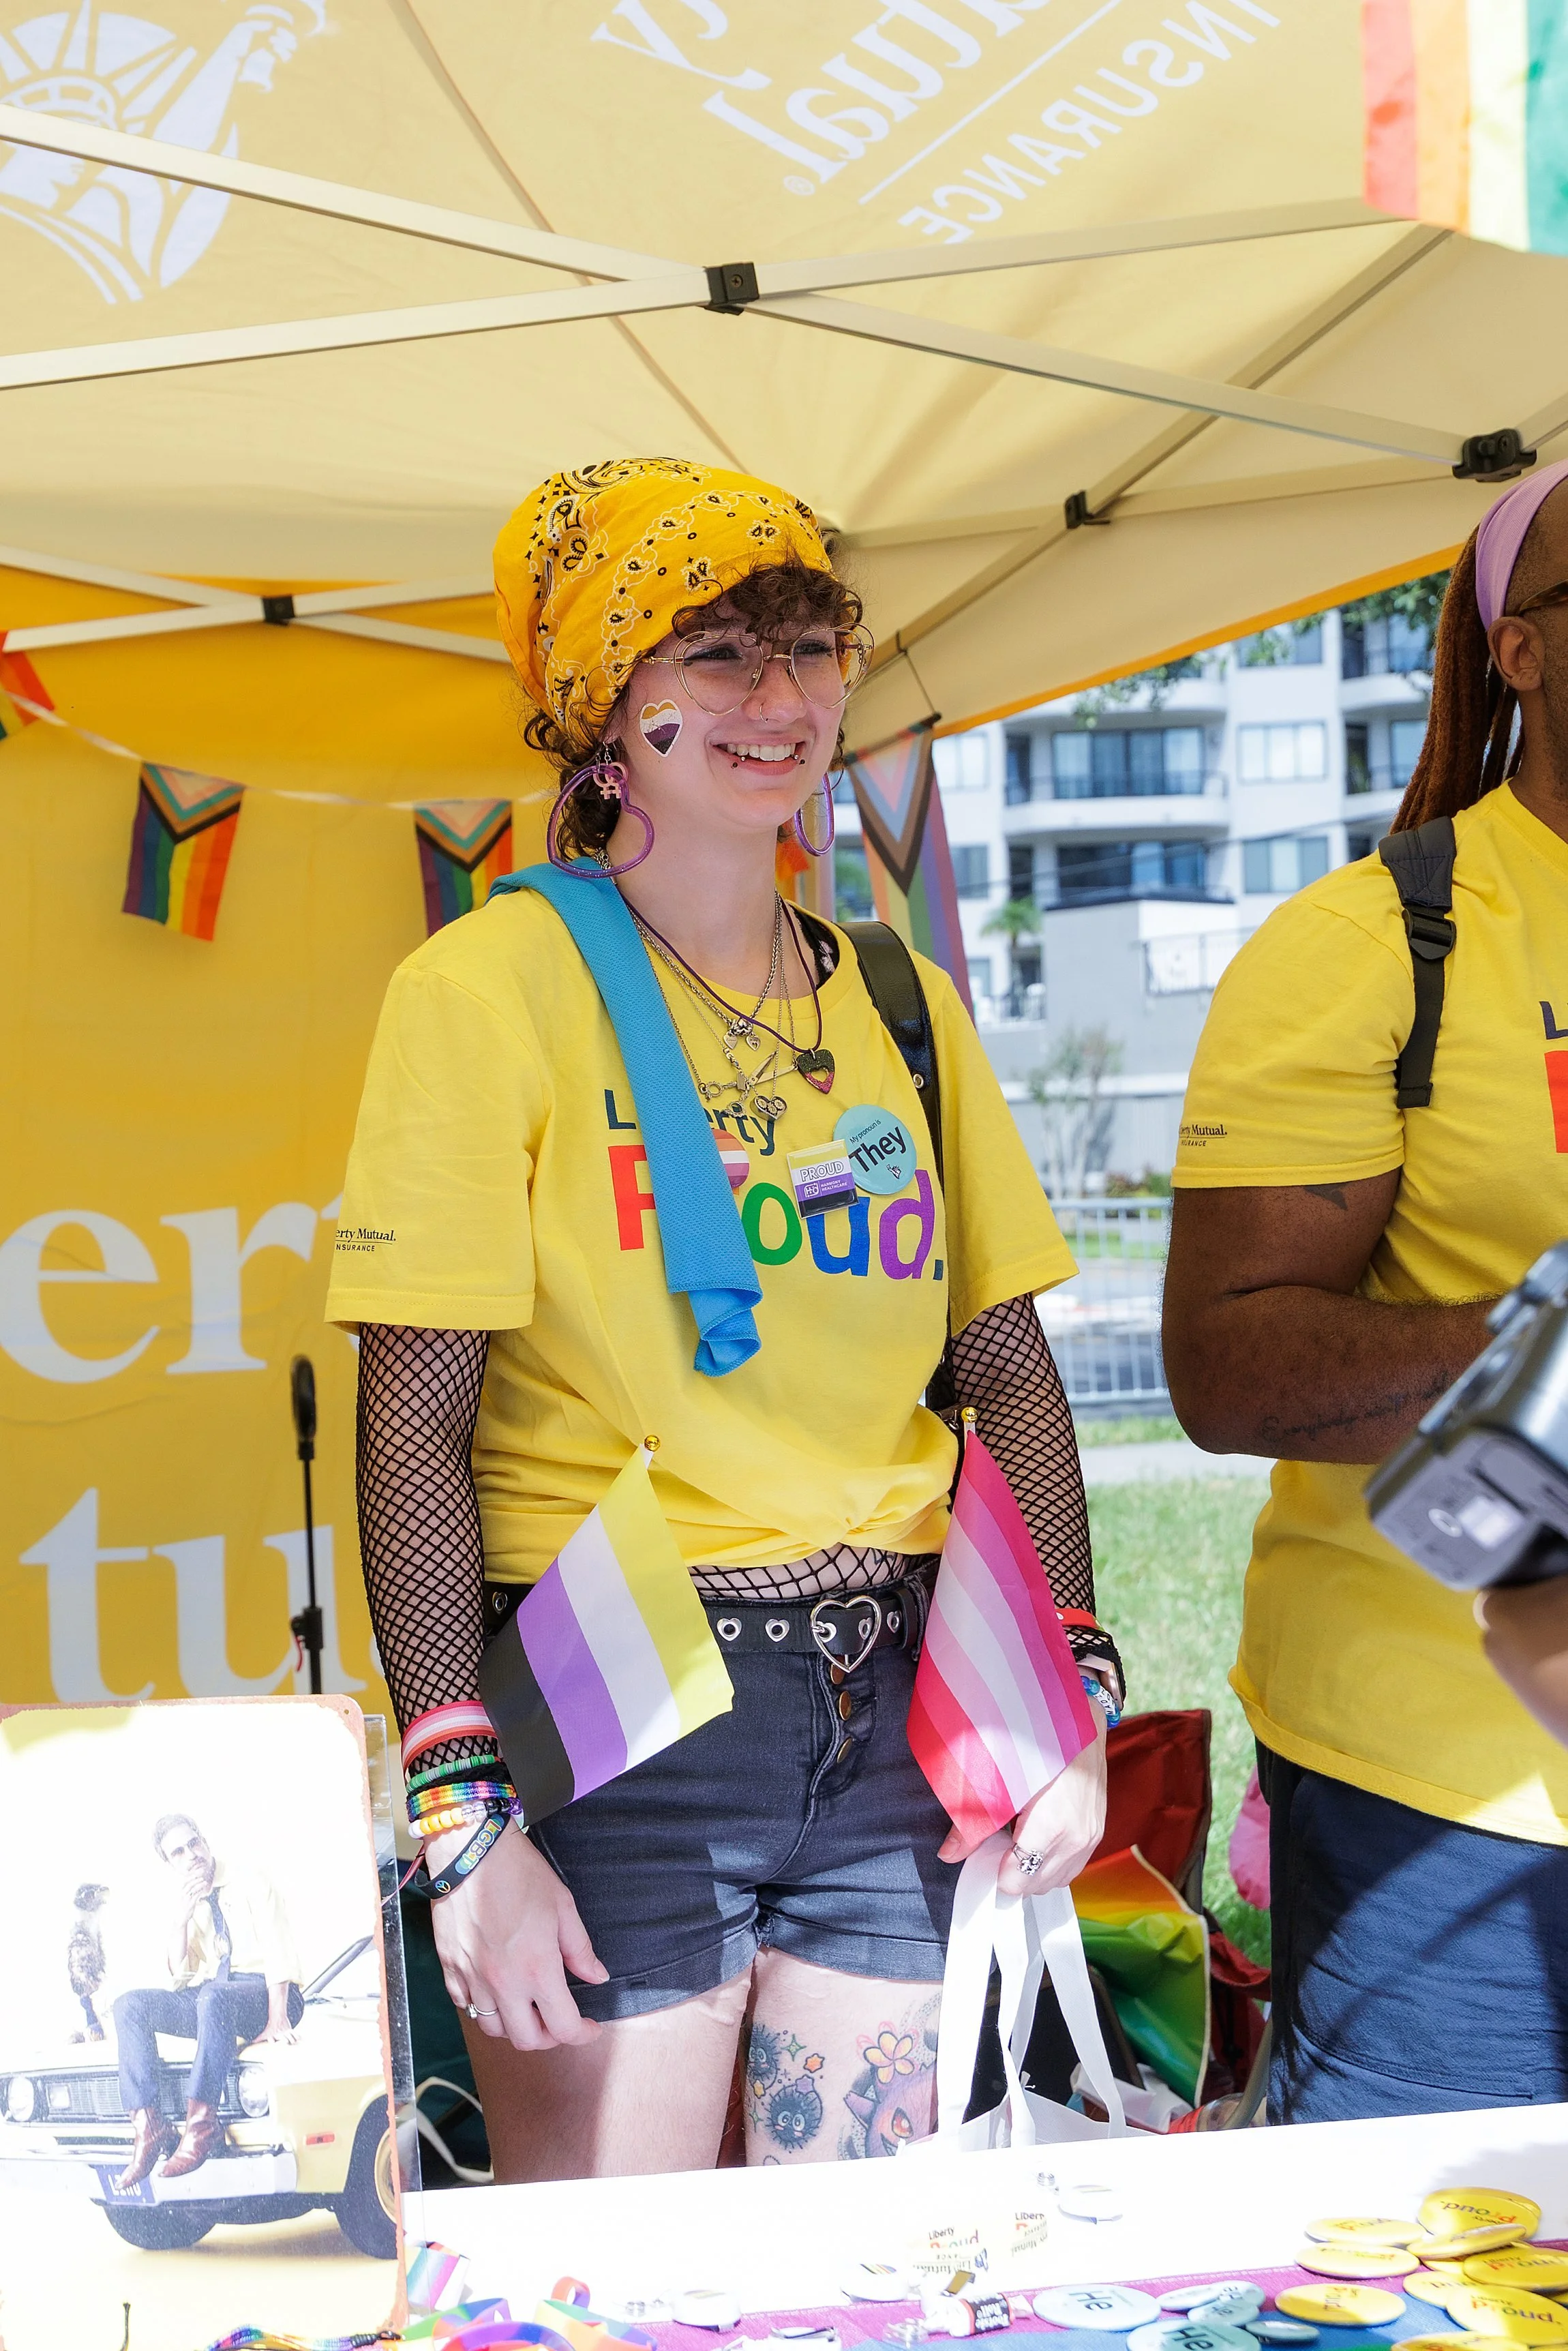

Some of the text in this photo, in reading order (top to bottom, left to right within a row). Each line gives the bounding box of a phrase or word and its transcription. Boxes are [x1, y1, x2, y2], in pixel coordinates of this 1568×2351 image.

[849, 1135, 859, 1144] My
[858, 1122, 877, 1139] pronoun
[1192, 1124, 1228, 1136] Mutual.
[847, 1126, 907, 1173] They
[800, 1160, 844, 1182] PROUD
[820, 1179, 841, 1187] HARMONY
[821, 1182, 848, 1192] HEALTHCARE
[608, 1145, 944, 1281] Poud.
[357, 1228, 397, 1242] Mutual.
[0, 1188, 359, 1383] er
[462, 1818, 502, 1870] LGBT
